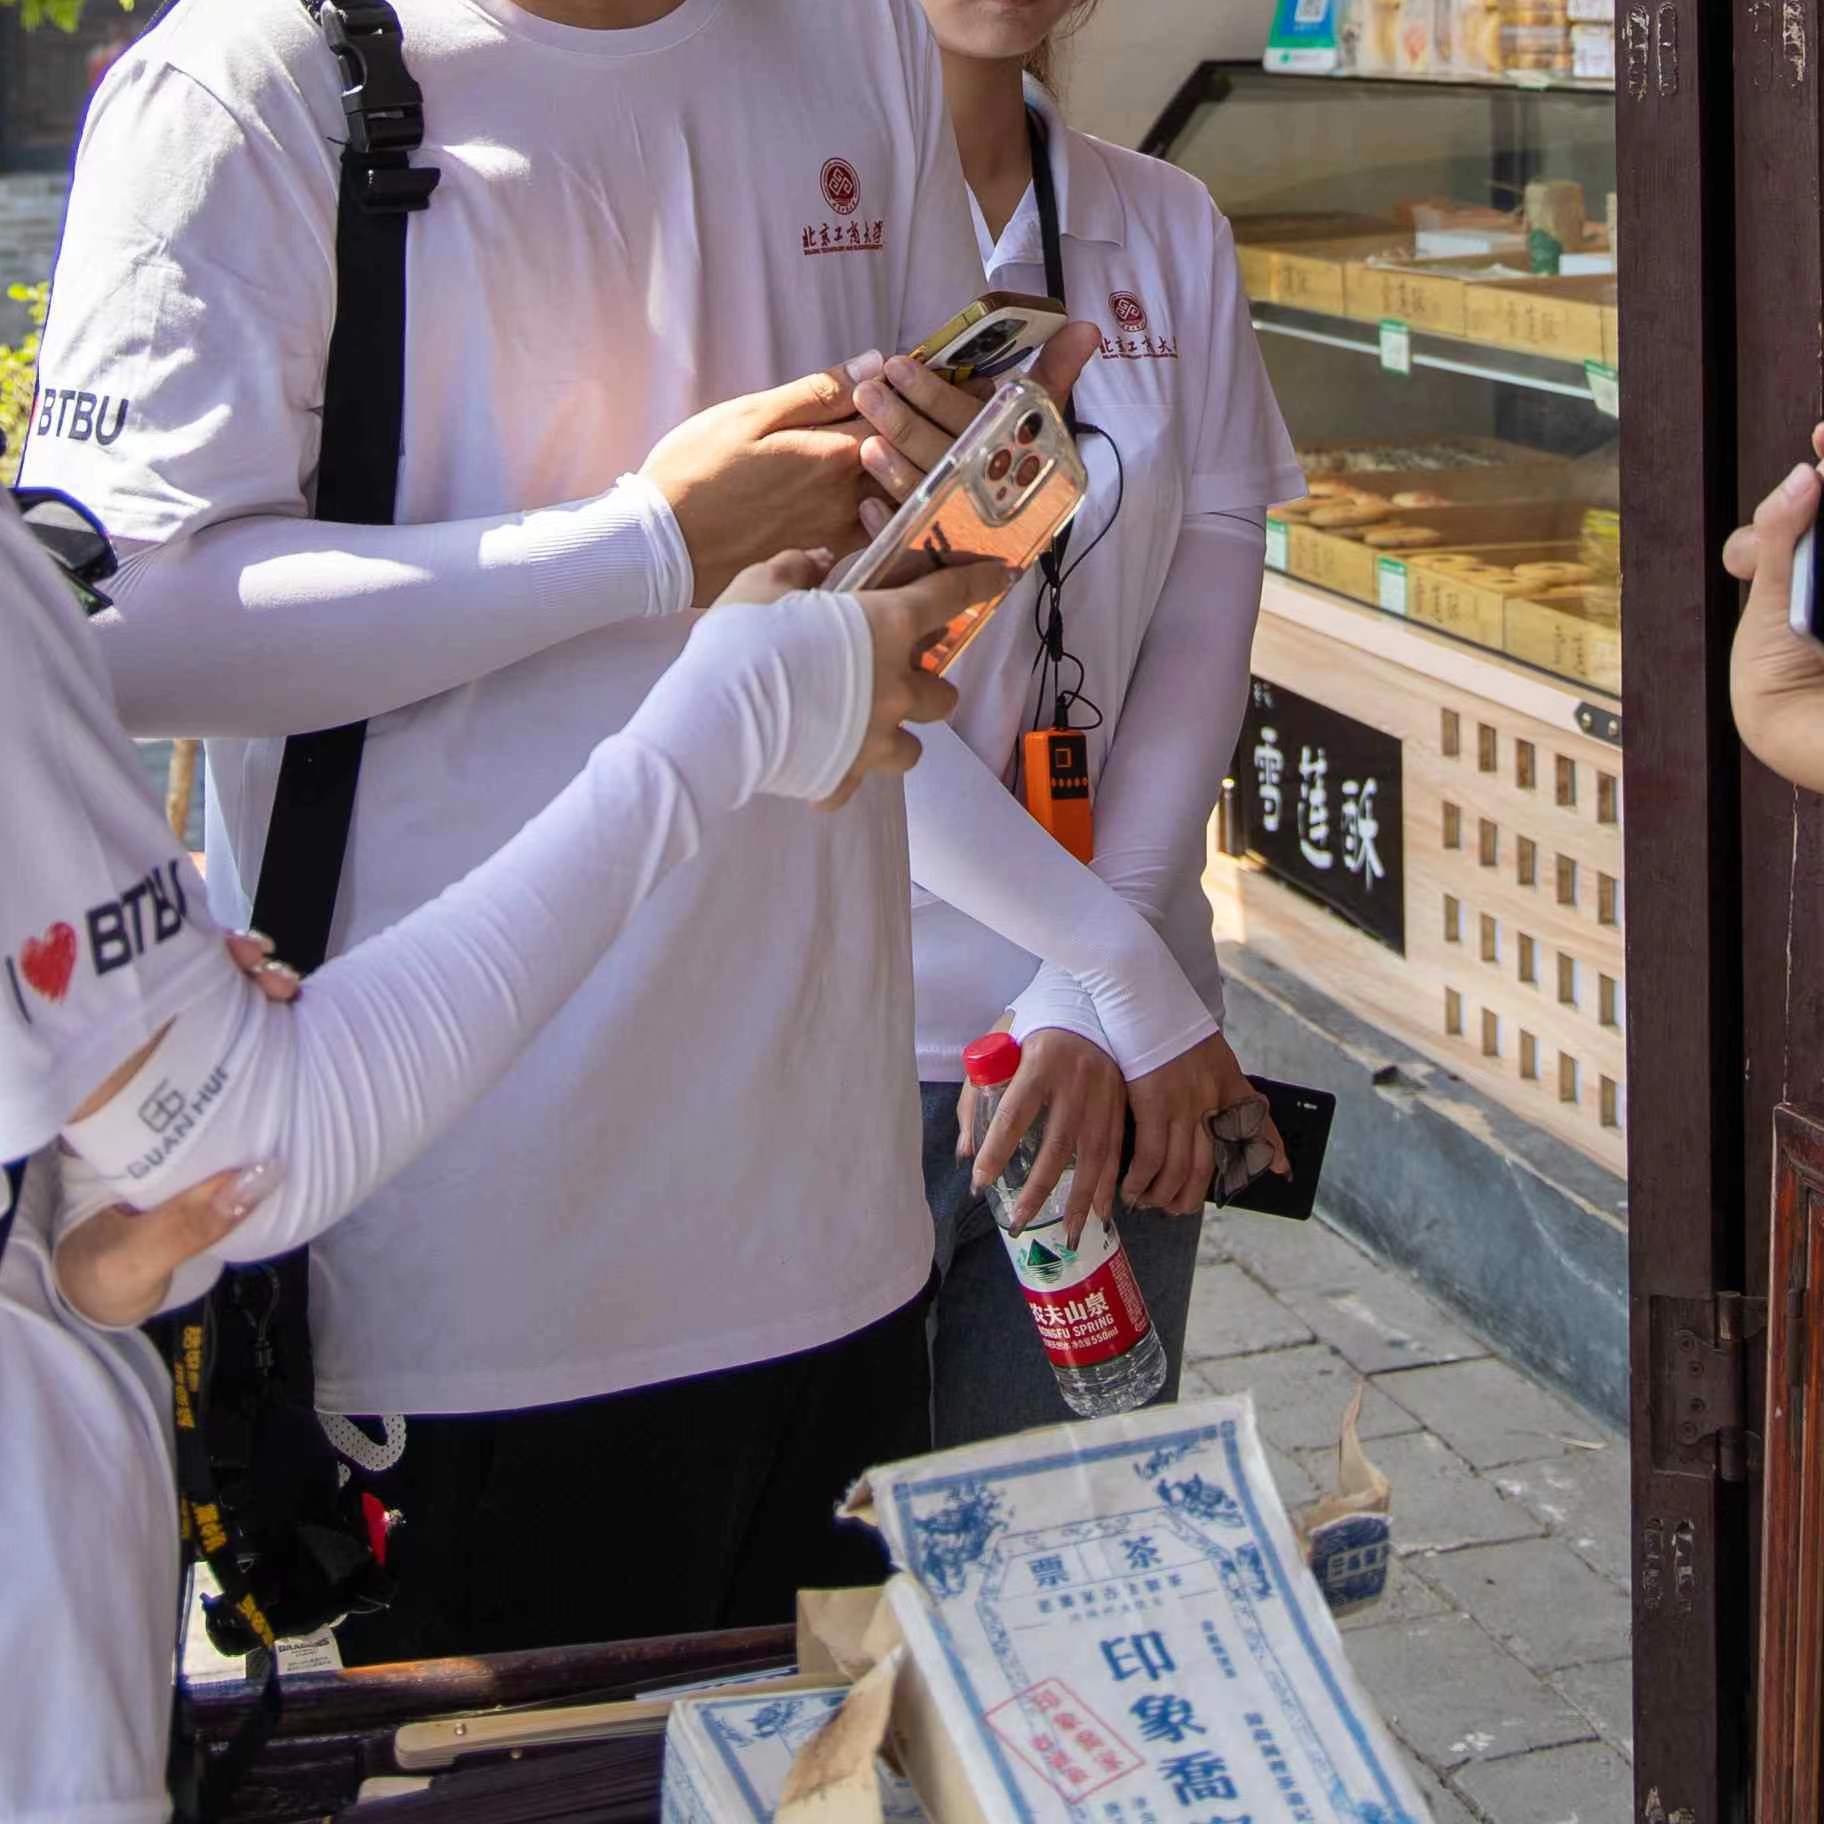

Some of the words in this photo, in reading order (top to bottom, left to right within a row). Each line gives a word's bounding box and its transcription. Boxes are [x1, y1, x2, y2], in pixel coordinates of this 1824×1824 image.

[1099, 334, 1179, 354] 北京工商大
[37, 387, 129, 446] BTBU
[1028, 1287, 1111, 1326] 农夫山泉
[1072, 1313, 1115, 1338] SPRING
[1098, 1630, 1253, 1824] 印象喬
